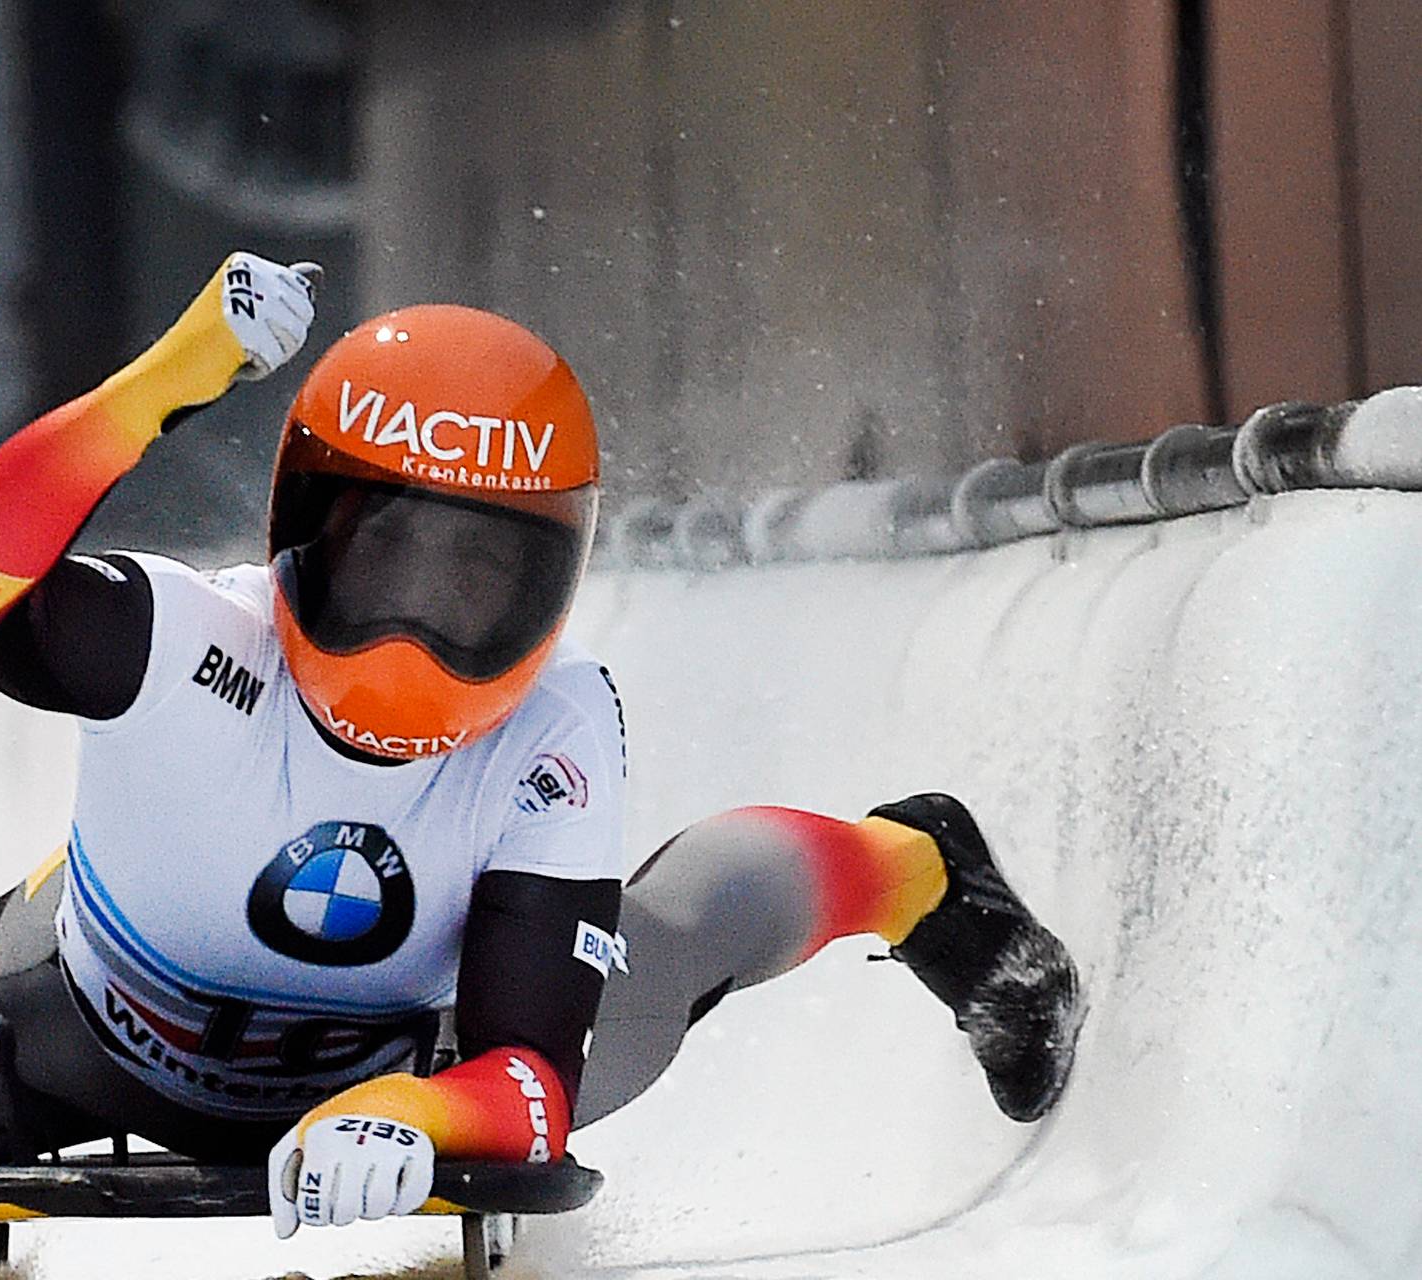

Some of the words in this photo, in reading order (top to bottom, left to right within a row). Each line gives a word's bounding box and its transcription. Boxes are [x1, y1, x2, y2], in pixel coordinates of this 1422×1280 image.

[226, 261, 264, 320] EIZ
[339, 379, 554, 472] VIACTIV
[401, 455, 551, 490] Krankenkasse
[192, 644, 265, 716] BMW
[325, 706, 467, 754] VIACTIV
[286, 824, 404, 879] BMW
